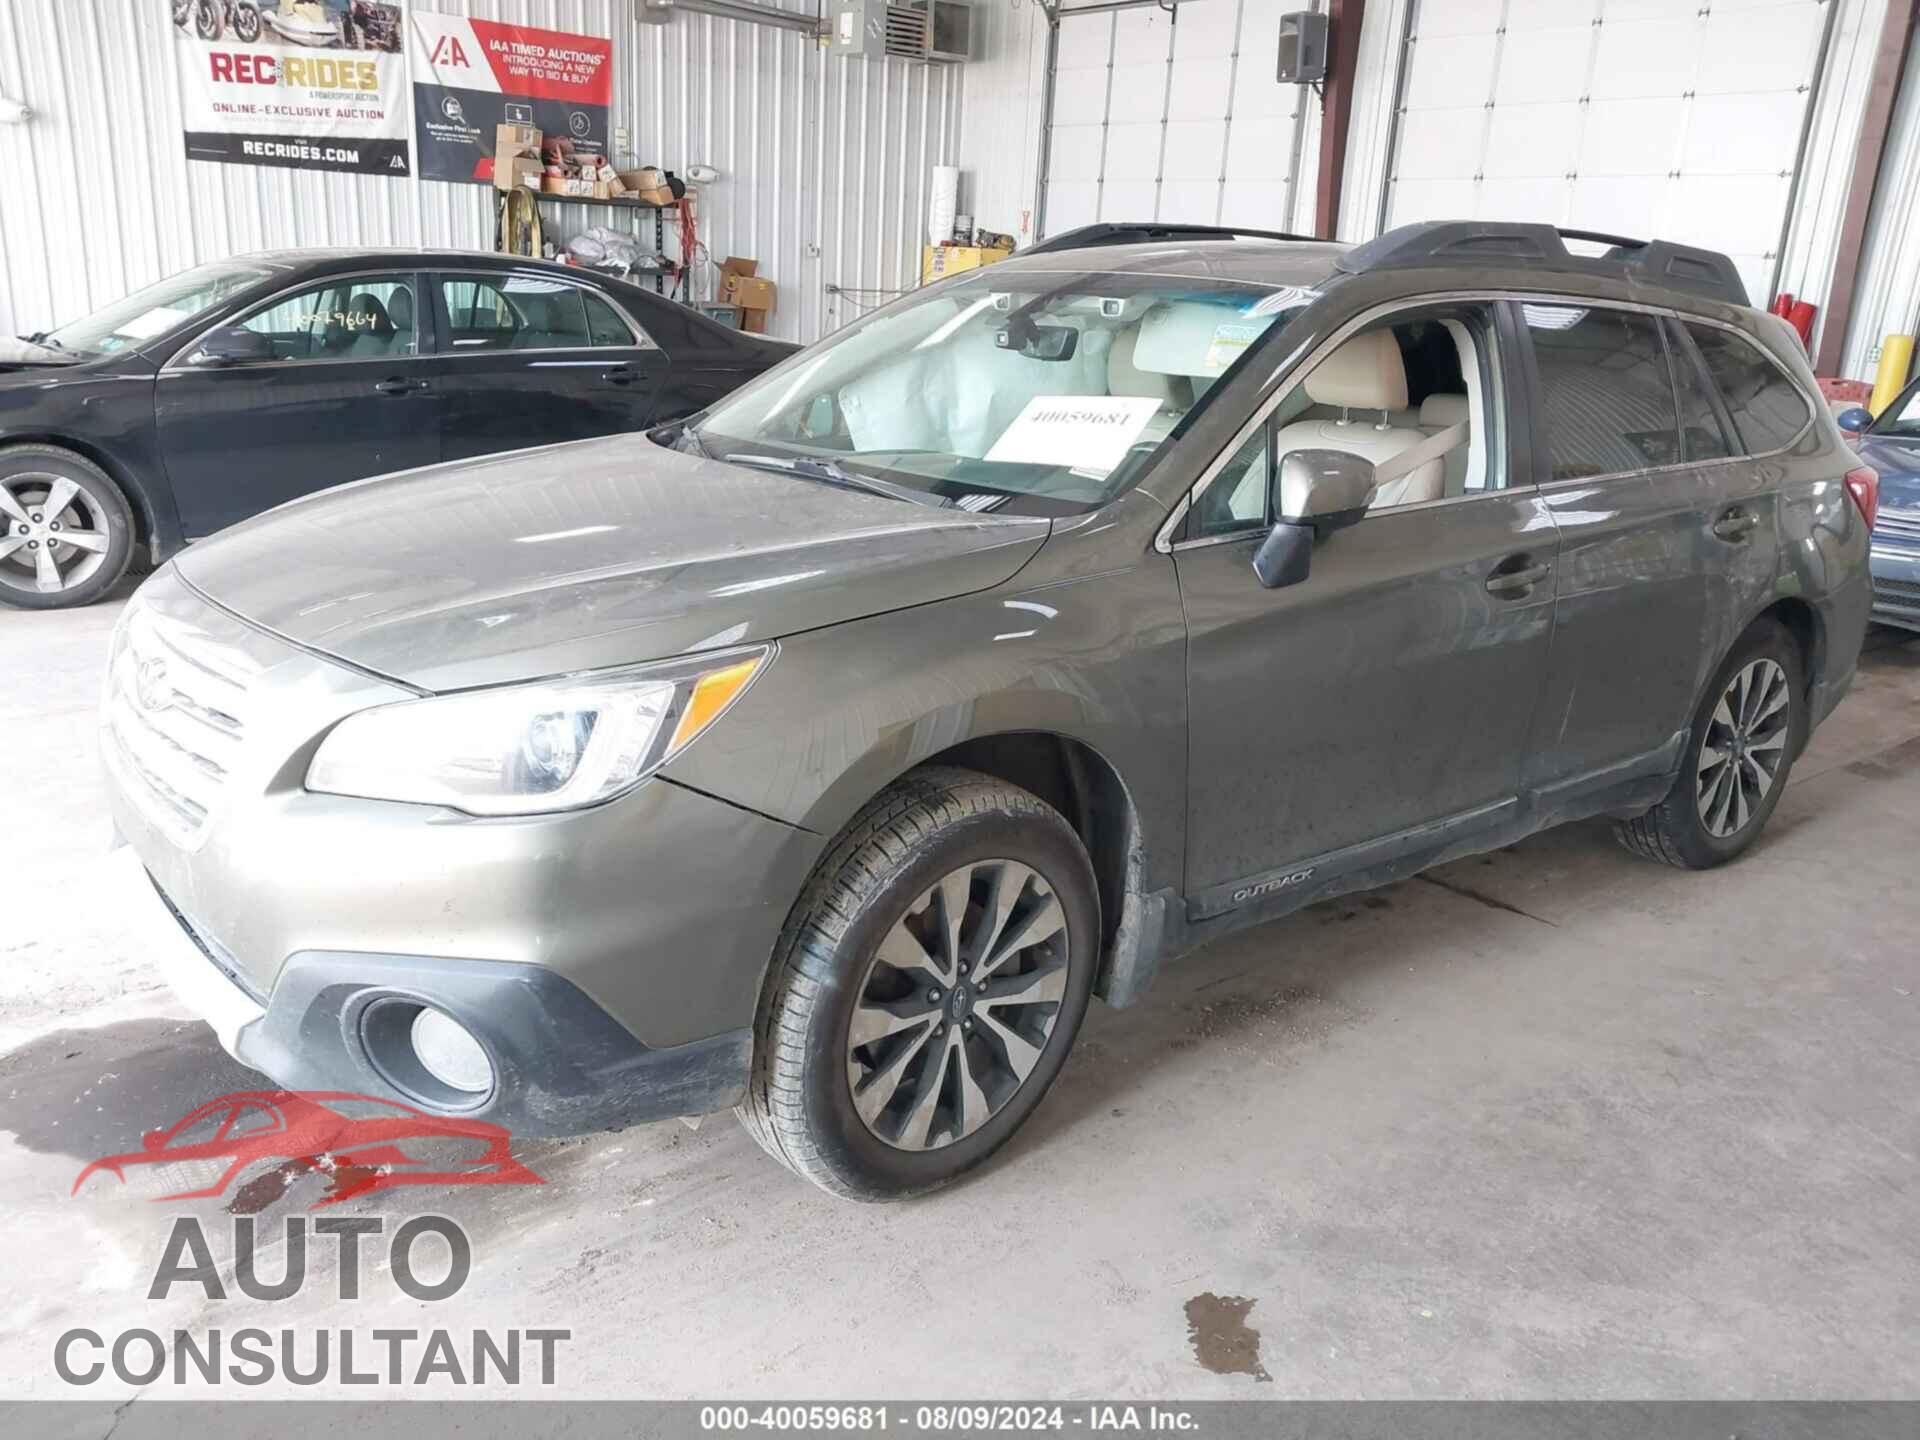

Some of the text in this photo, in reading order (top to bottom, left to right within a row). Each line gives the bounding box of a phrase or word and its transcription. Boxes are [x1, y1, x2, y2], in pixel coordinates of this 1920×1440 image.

[489, 40, 509, 52] IAA
[510, 43, 545, 58] TIMED
[209, 52, 277, 85] REC
[282, 57, 379, 91] RIDES
[503, 55, 597, 75] INTRODUCING A NEW
[509, 66, 590, 84] WAY TO BID & BUY
[213, 103, 385, 120] ONLINE-EXCLUSIVE AUCTION
[243, 141, 360, 164] RECRIDES.COM
[1030, 409, 1132, 427] 40059681
[1234, 867, 1315, 901] OUTBACK
